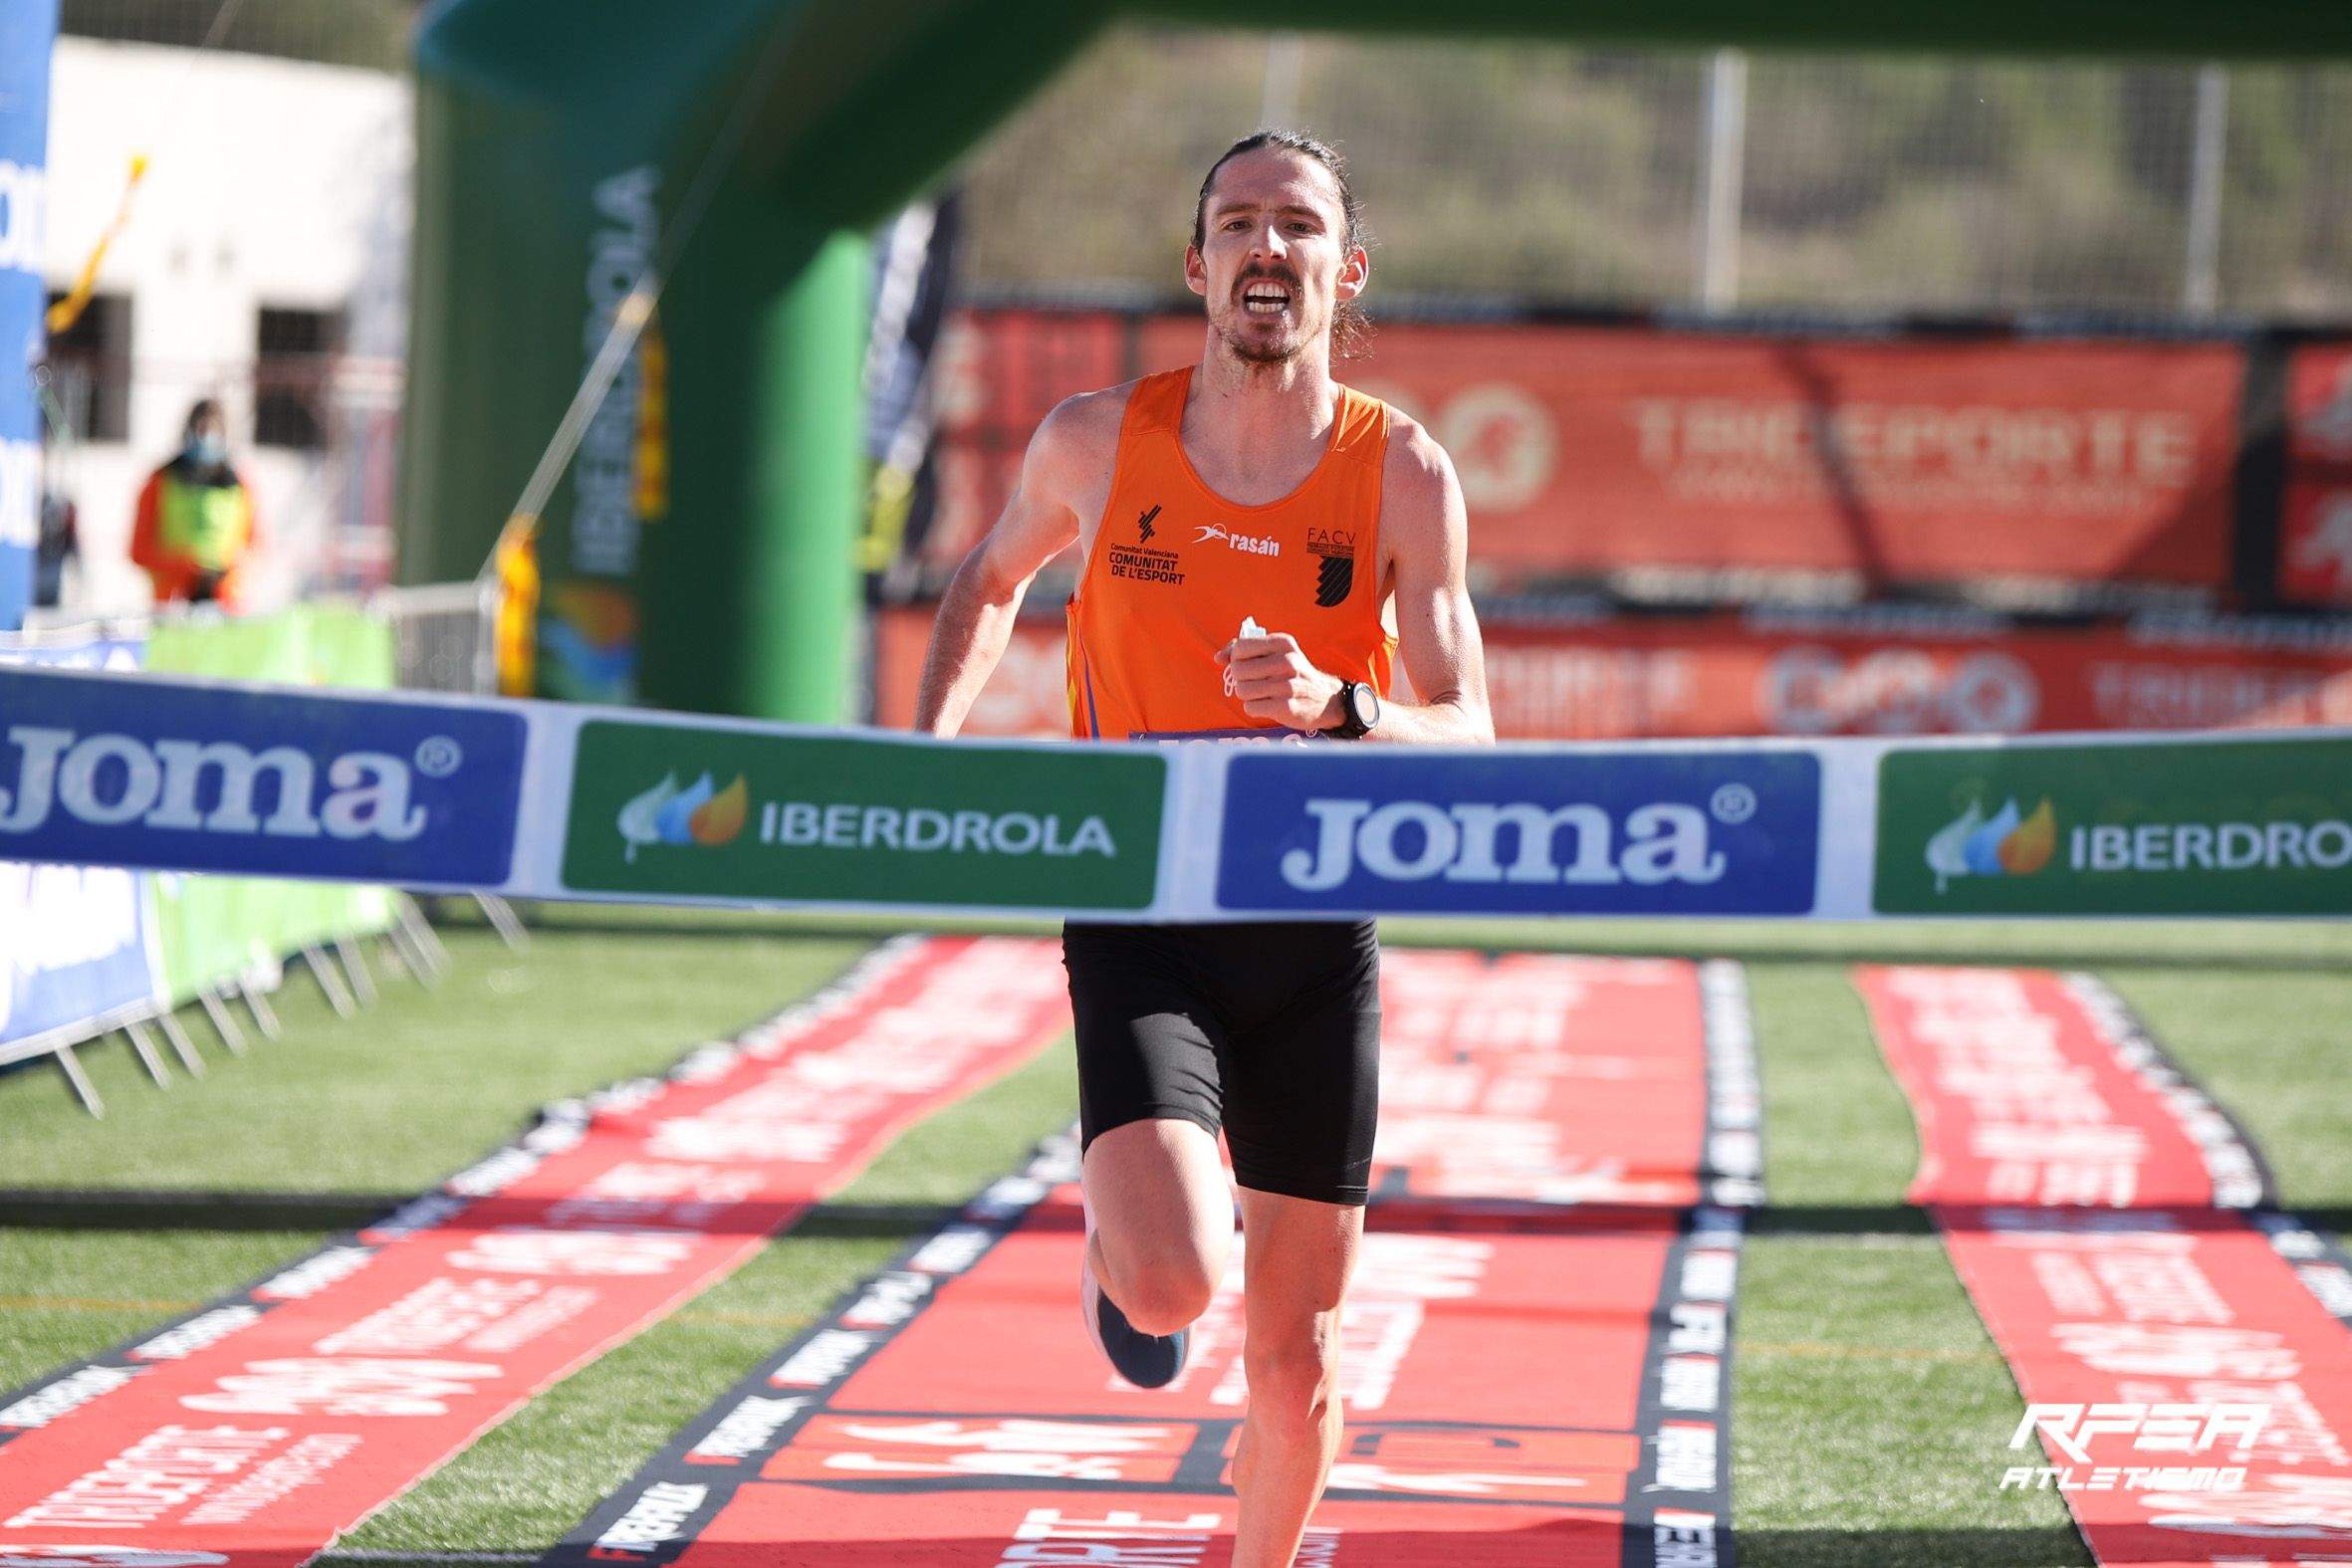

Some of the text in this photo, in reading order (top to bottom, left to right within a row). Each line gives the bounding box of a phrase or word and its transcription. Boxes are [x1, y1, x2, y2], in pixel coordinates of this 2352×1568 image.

[1229, 533, 1281, 558] rasán
[1307, 527, 1356, 545] FACV
[1108, 552, 1179, 572] COMUNITAT
[1110, 543, 1179, 560] Comunitat Valenciana
[1111, 564, 1186, 585] DE L'ESPORT
[760, 800, 1116, 858] IBERDROLA
[2069, 820, 2352, 871] IBERDRO
